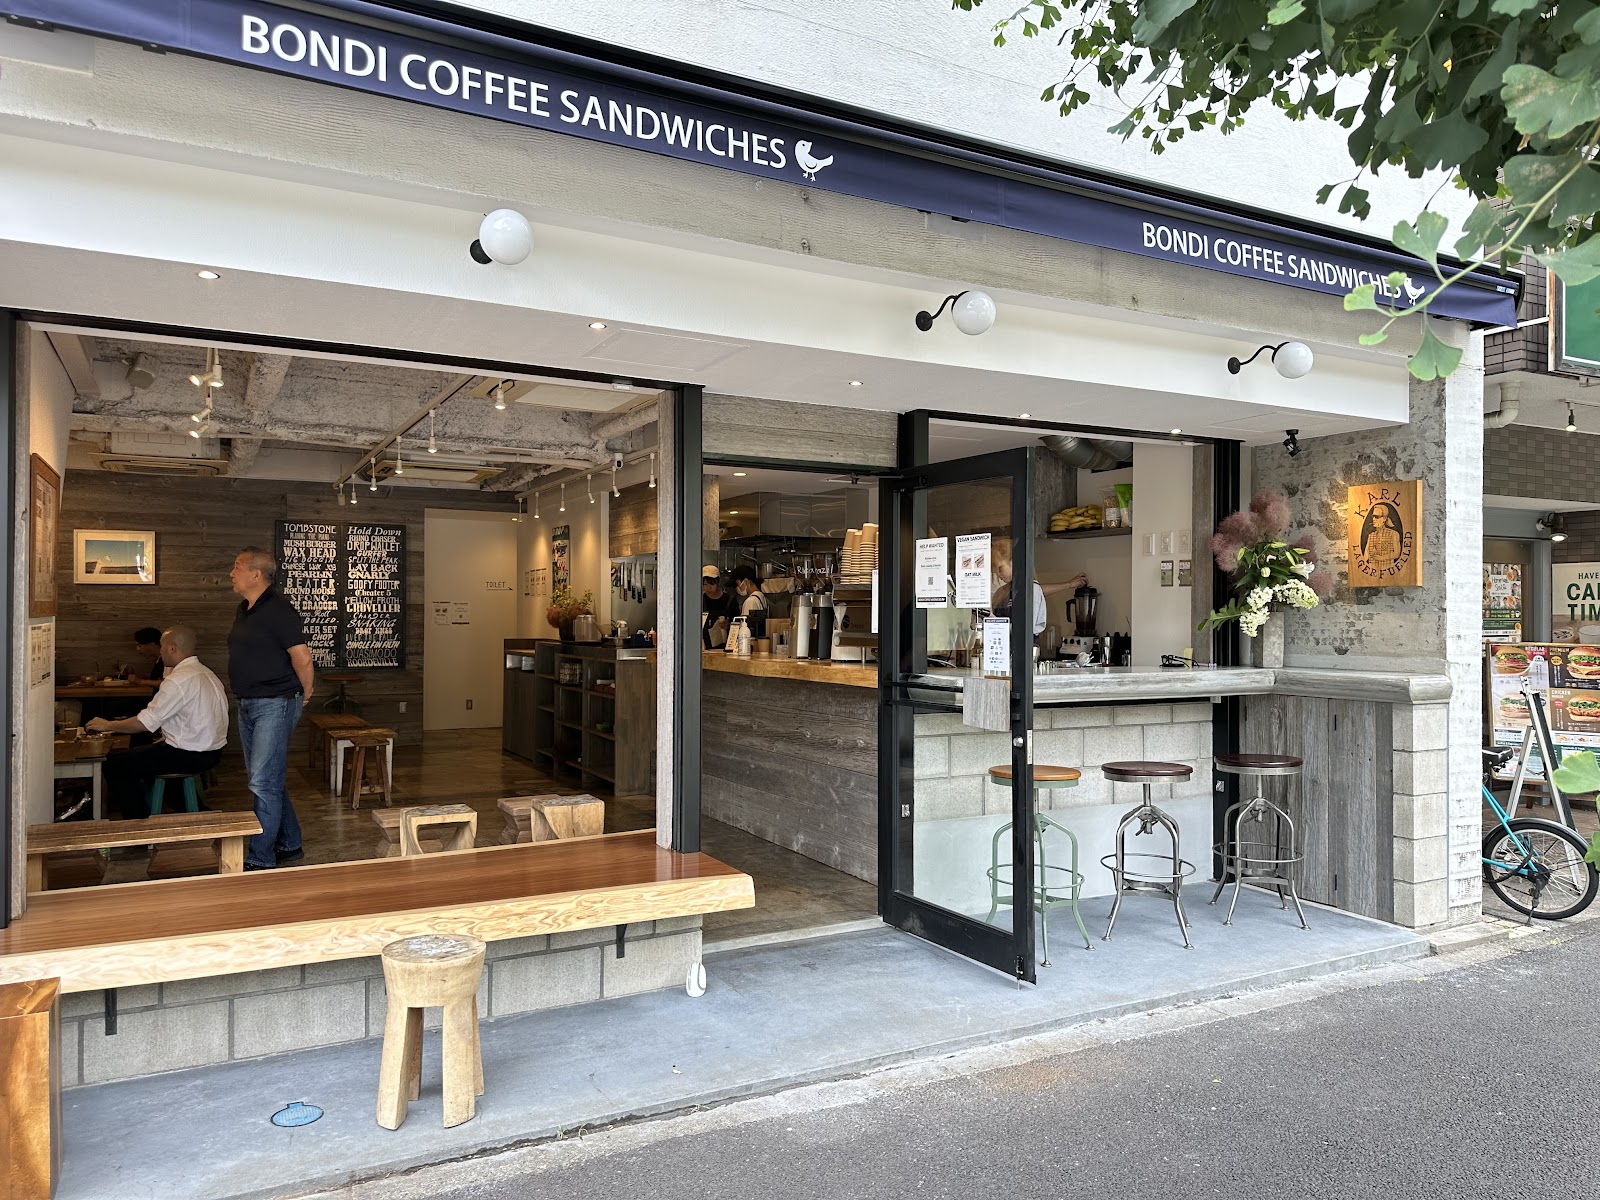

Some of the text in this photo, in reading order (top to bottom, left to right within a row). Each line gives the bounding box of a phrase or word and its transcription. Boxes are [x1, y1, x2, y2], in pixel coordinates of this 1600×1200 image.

[242, 15, 786, 169] BONDI COFFEE SANDWICHES
[1143, 222, 1209, 259] BONDI
[1214, 238, 1284, 275] COFFEE
[1354, 489, 1400, 519] KARL
[284, 524, 336, 533] TOMBSTONE
[348, 526, 401, 536] Hold Down
[284, 547, 336, 558] WAX HEAD
[371, 564, 398, 572] BACK
[287, 578, 335, 588] BEATER
[348, 580, 400, 589] GOOFY FOOTER
[302, 601, 338, 610] DRAGGER
[347, 619, 397, 627] SNAKING
